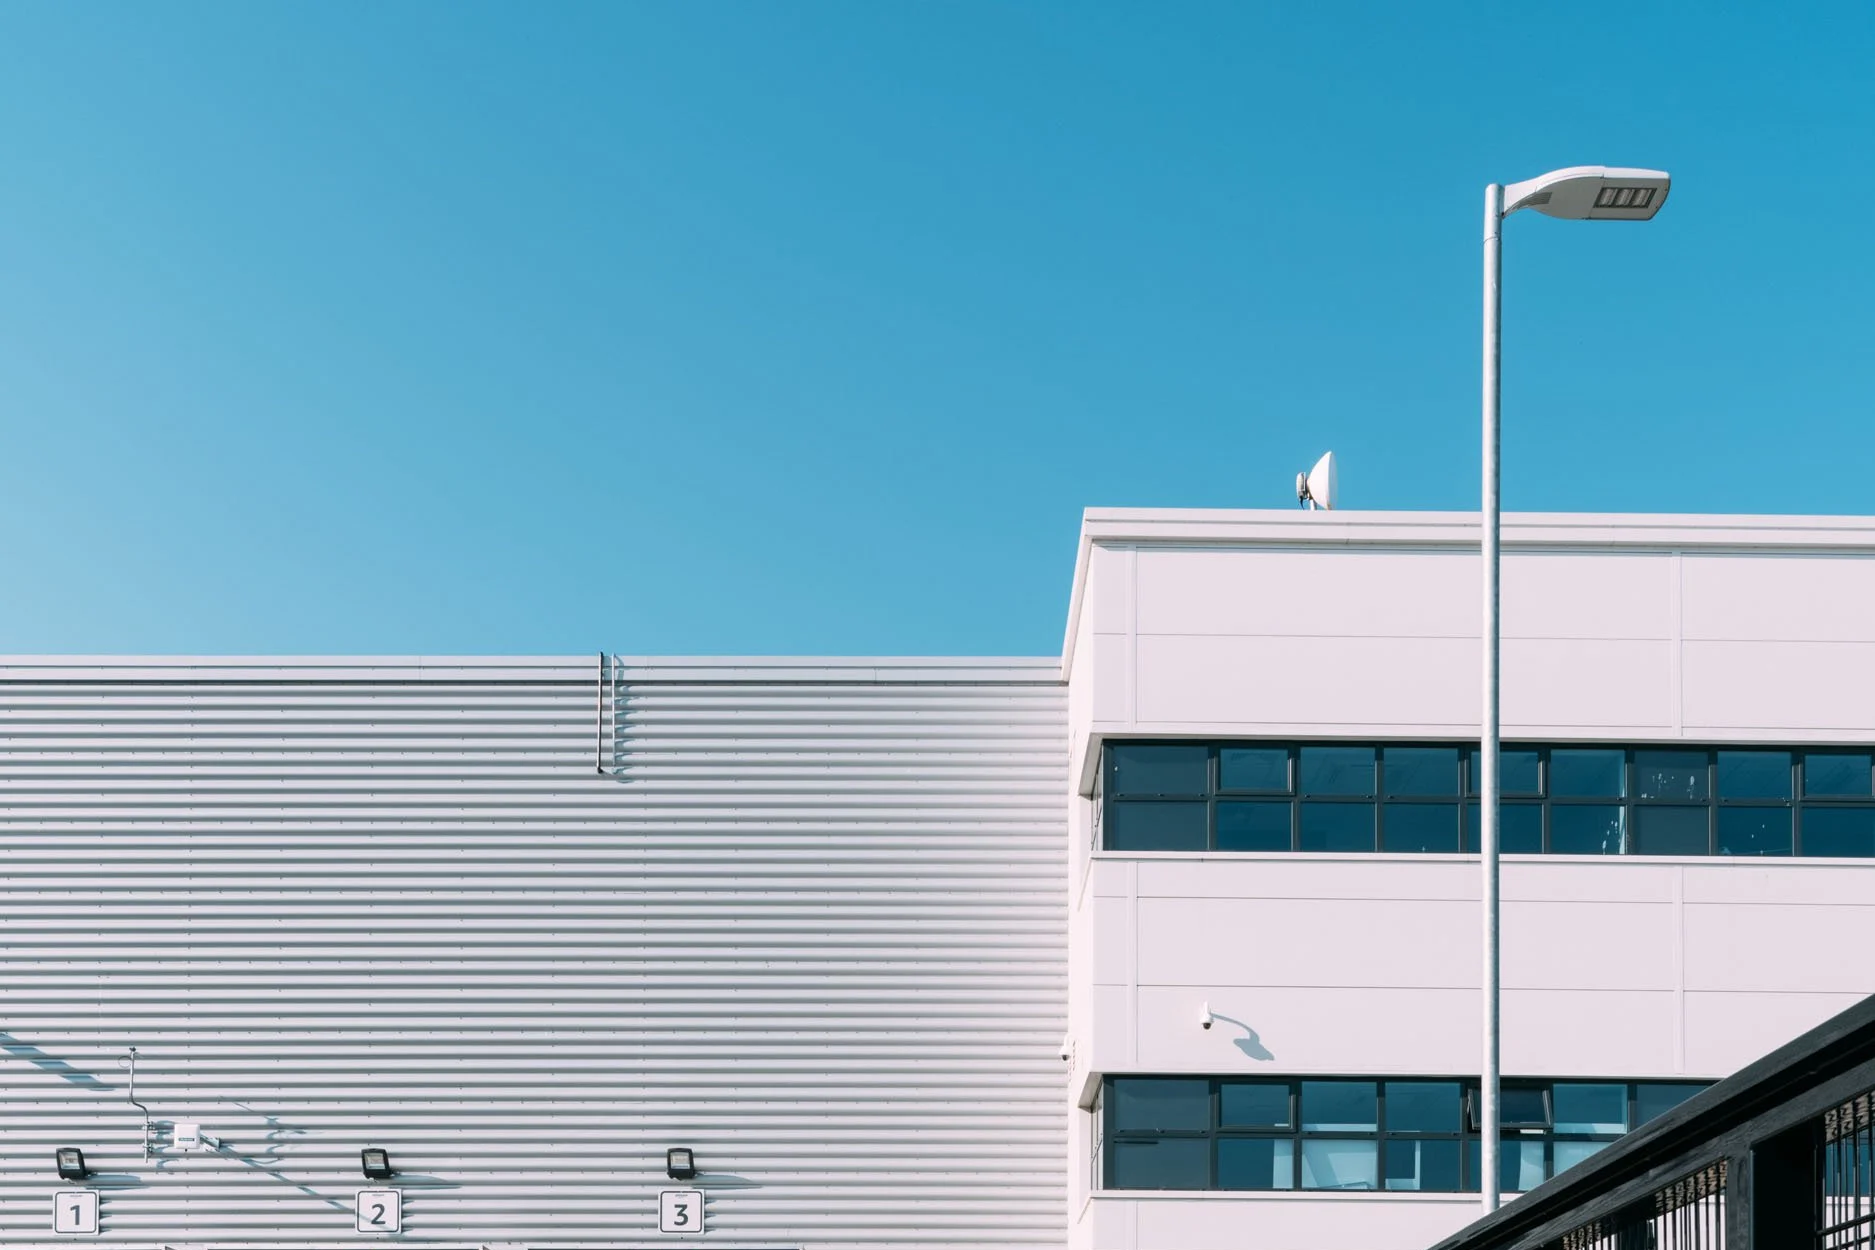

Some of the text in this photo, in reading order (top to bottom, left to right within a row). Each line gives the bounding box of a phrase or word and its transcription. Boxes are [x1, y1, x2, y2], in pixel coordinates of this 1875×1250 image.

[70, 1205, 80, 1225] 1
[371, 1203, 386, 1225] 2
[673, 1204, 689, 1226] 3
